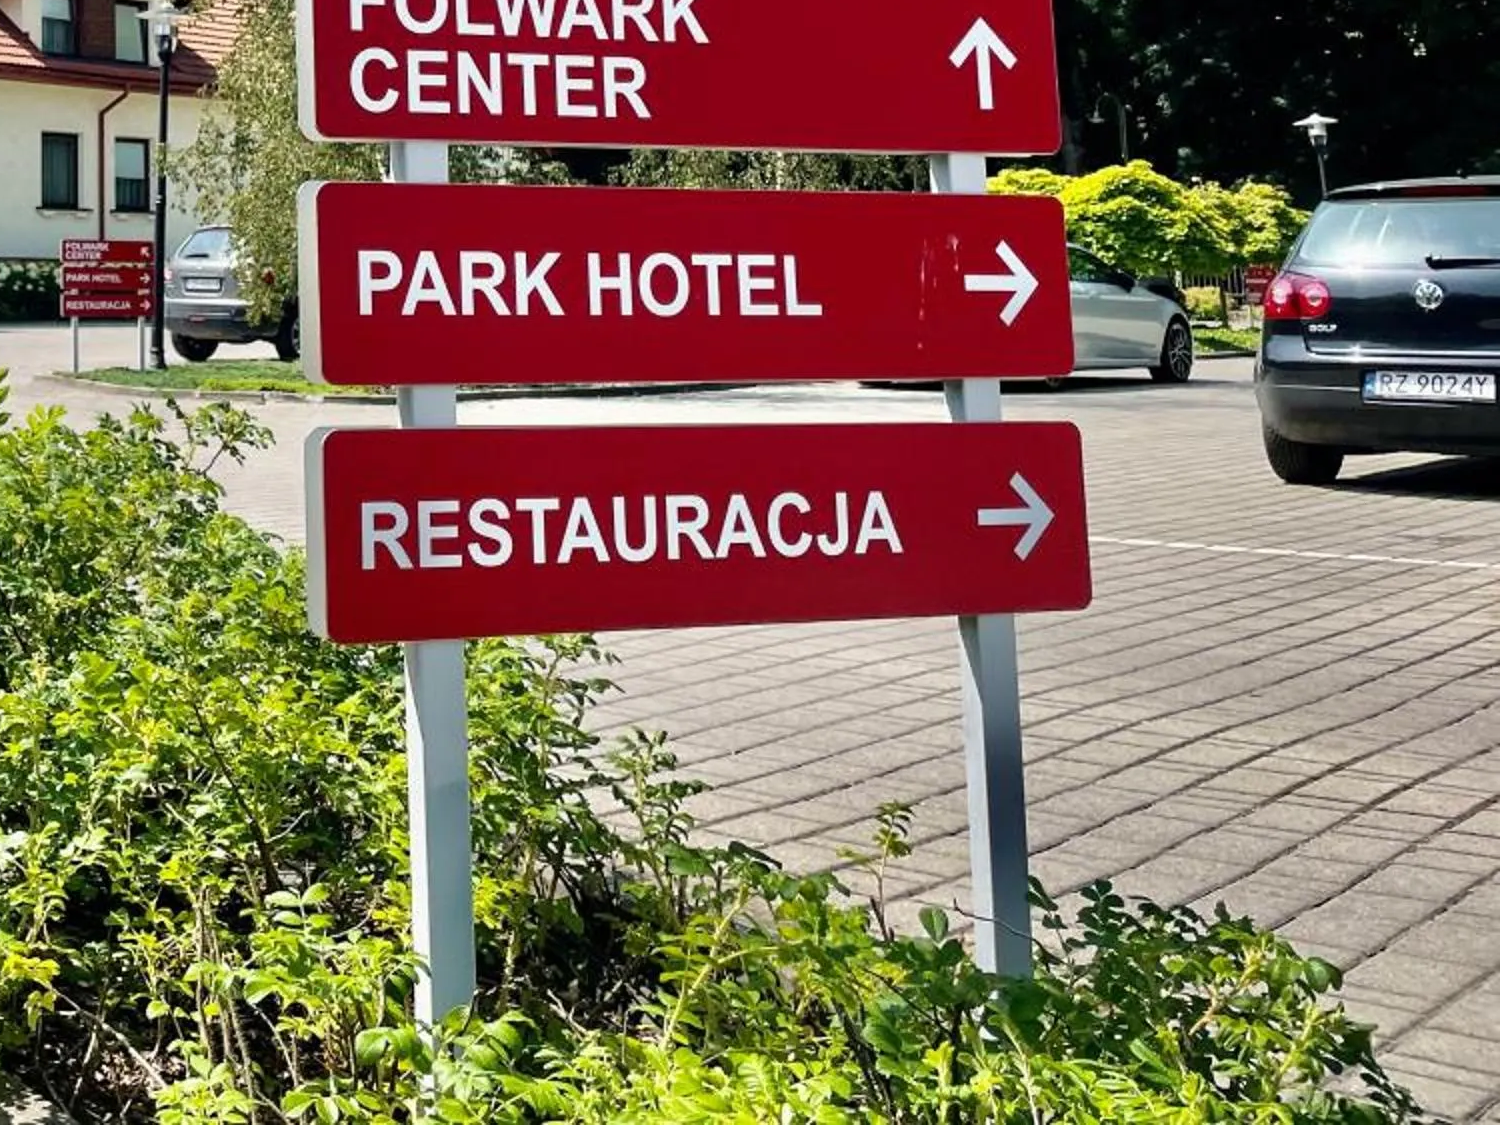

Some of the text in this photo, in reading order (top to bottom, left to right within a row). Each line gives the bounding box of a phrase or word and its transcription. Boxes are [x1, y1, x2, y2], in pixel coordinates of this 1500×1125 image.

[350, 47, 651, 119] CENTER
[65, 273, 123, 284] PARK HOTEL
[357, 250, 823, 317] PARK HOTEL
[65, 300, 132, 310] RESTAURACJA
[1381, 373, 1488, 396] RZ 9024Y
[361, 490, 903, 570] RESTAURACJA
